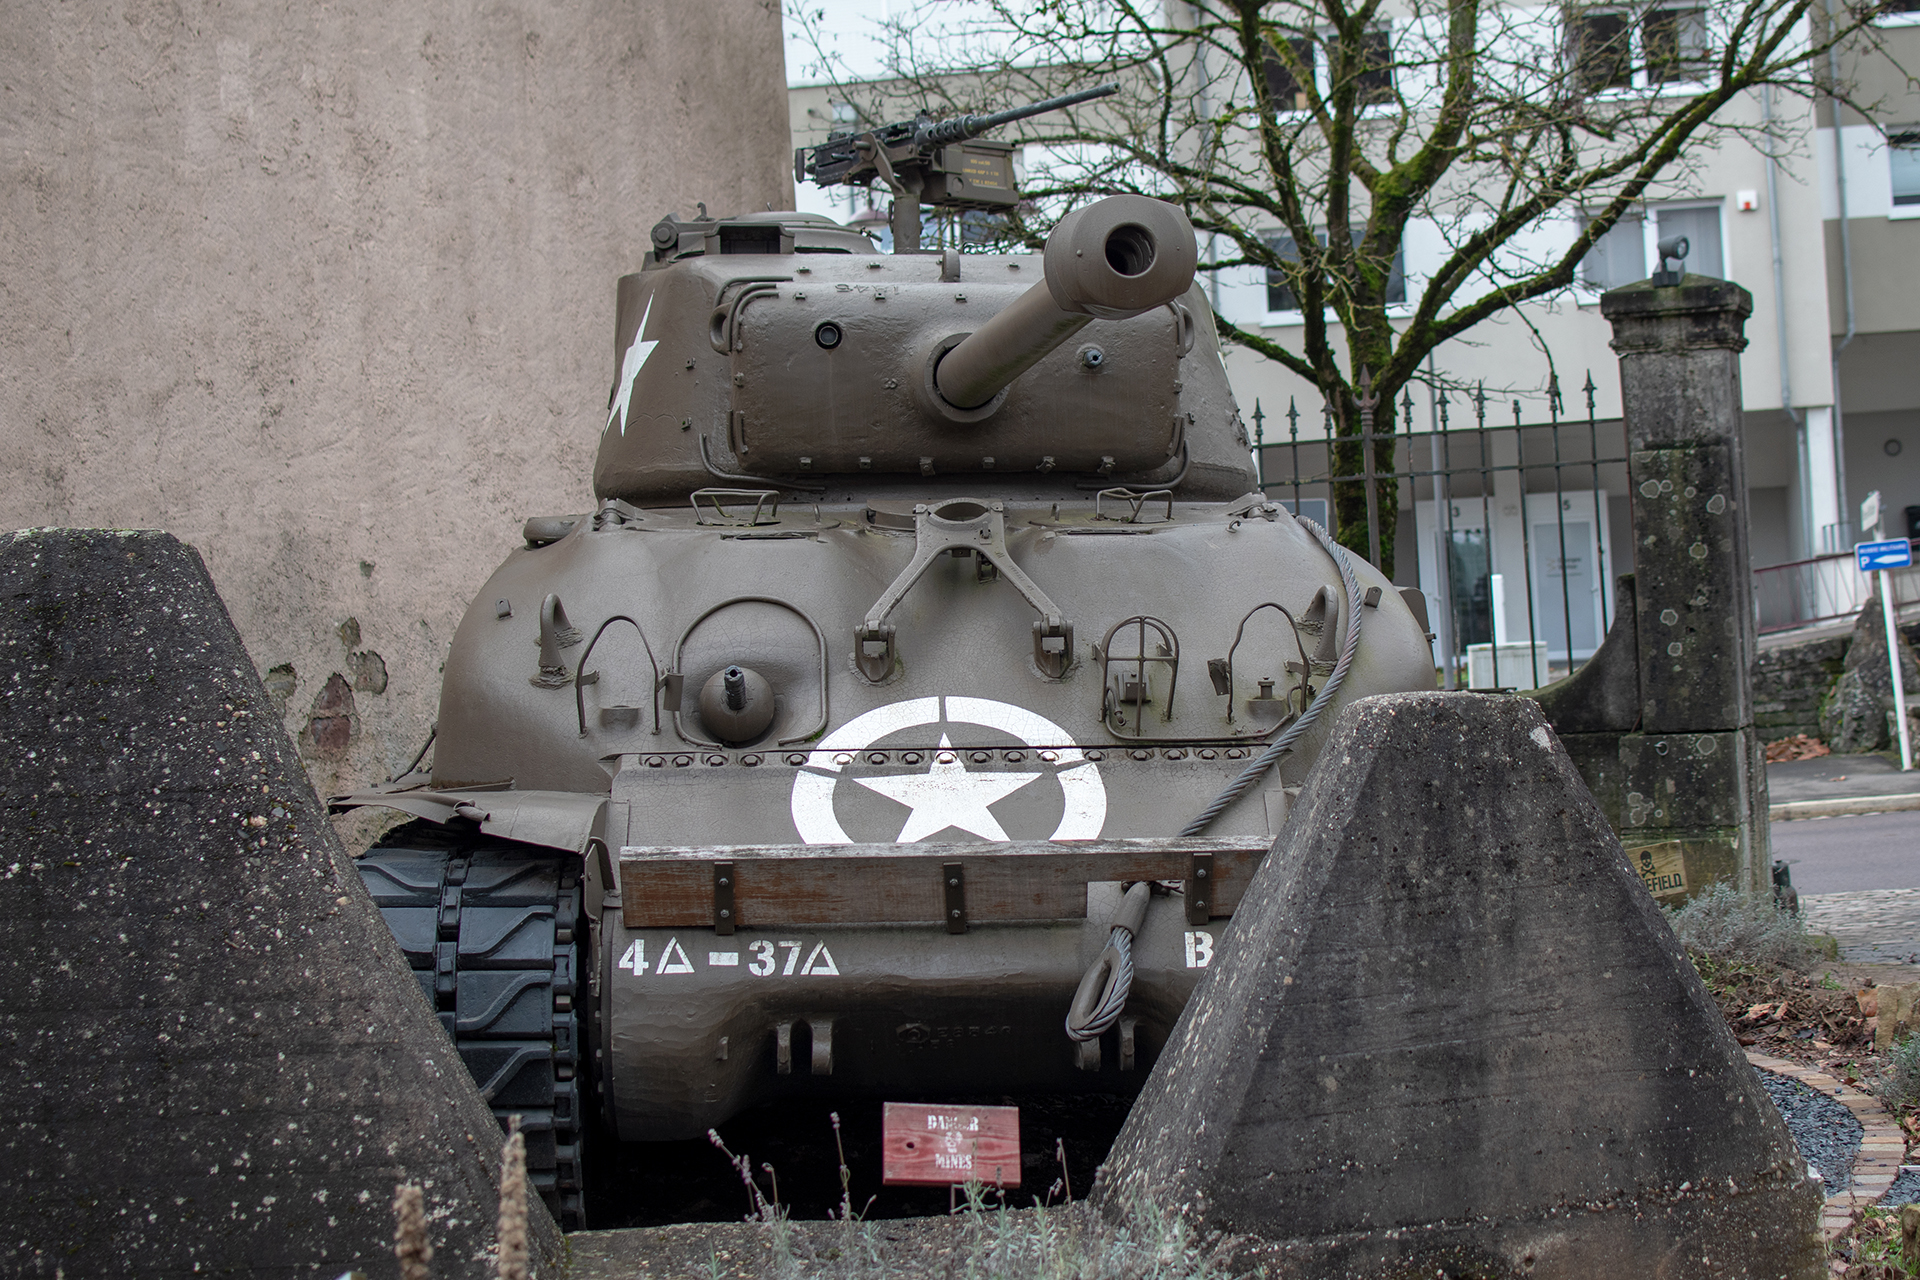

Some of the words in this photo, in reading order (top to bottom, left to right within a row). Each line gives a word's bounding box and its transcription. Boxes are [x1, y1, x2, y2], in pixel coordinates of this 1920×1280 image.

[1860, 556, 1870, 568] P
[1643, 873, 1682, 892] EFIELD
[1184, 931, 1214, 968] B
[935, 1153, 973, 1170] MINES
